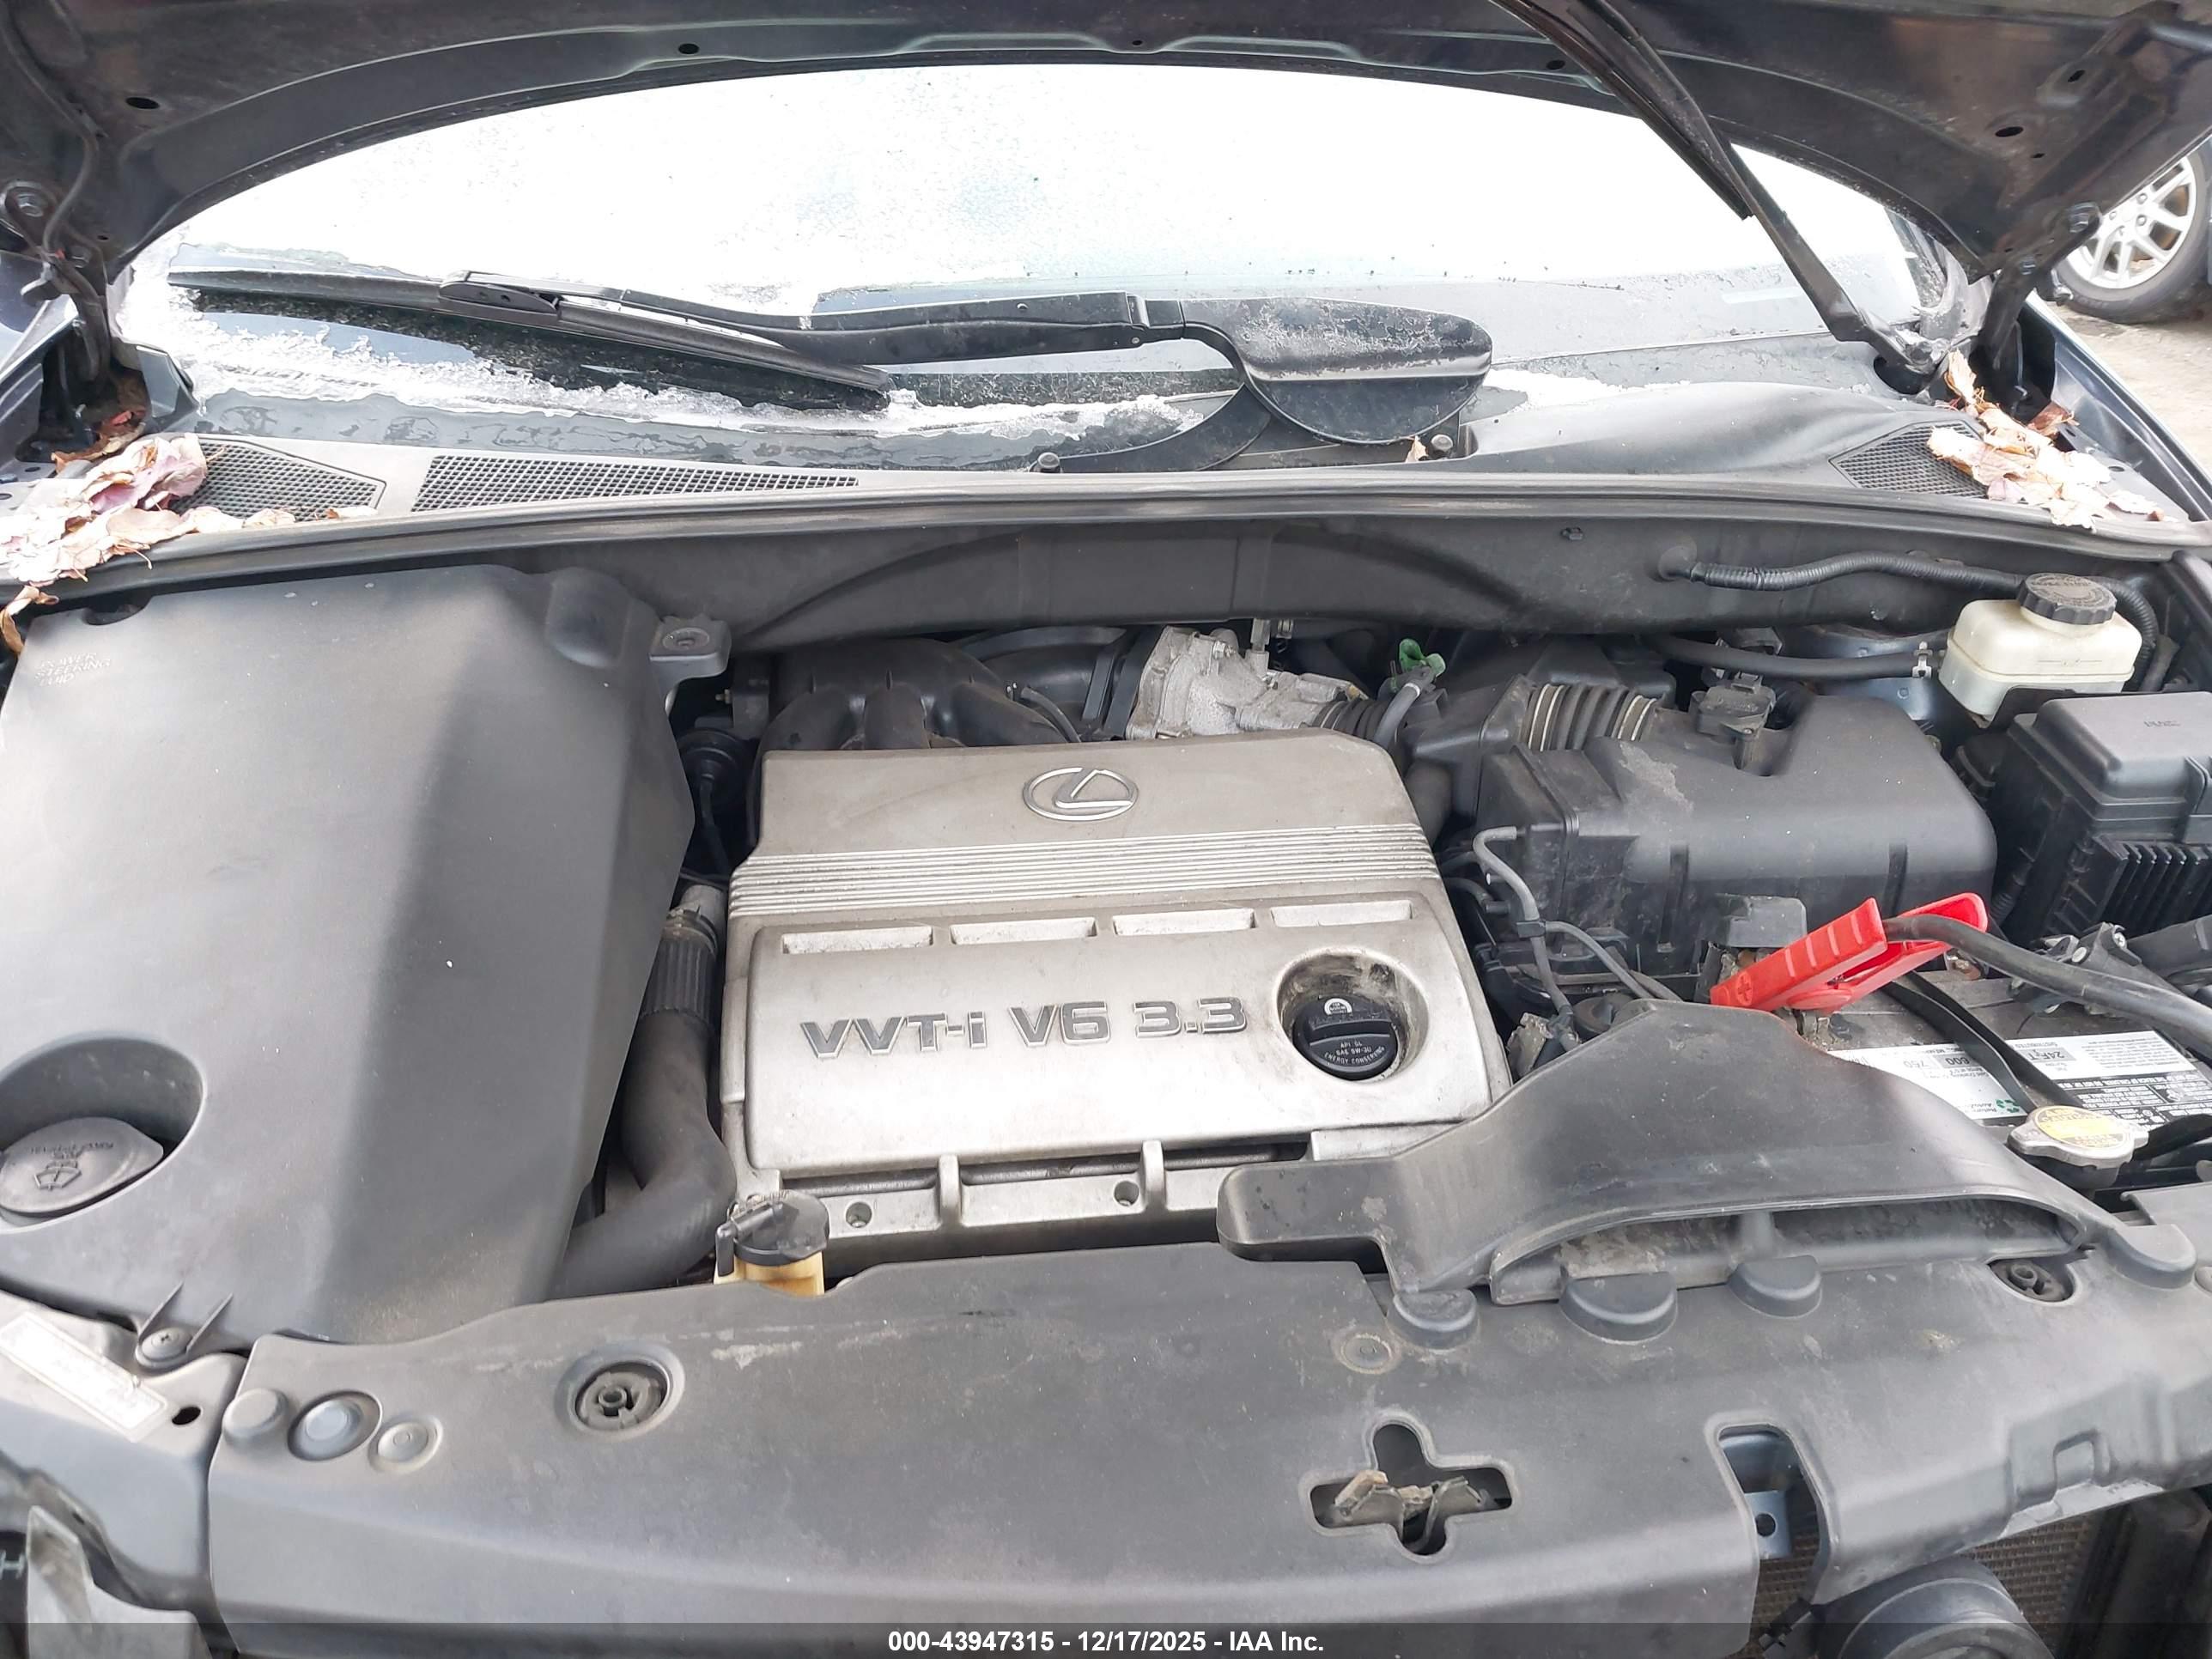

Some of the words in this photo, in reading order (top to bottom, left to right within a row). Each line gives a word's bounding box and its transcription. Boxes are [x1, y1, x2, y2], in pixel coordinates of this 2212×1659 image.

[800, 1012, 988, 1059] VVT-i
[1007, 1000, 1111, 1047] V6
[1133, 996, 1249, 1037] 3.3
[1335, 1048, 1350, 1056] SAE
[1351, 1046, 1372, 1054] 5W-30
[1324, 1052, 1349, 1065] ENERGY
[1945, 1057, 1970, 1066] 600
